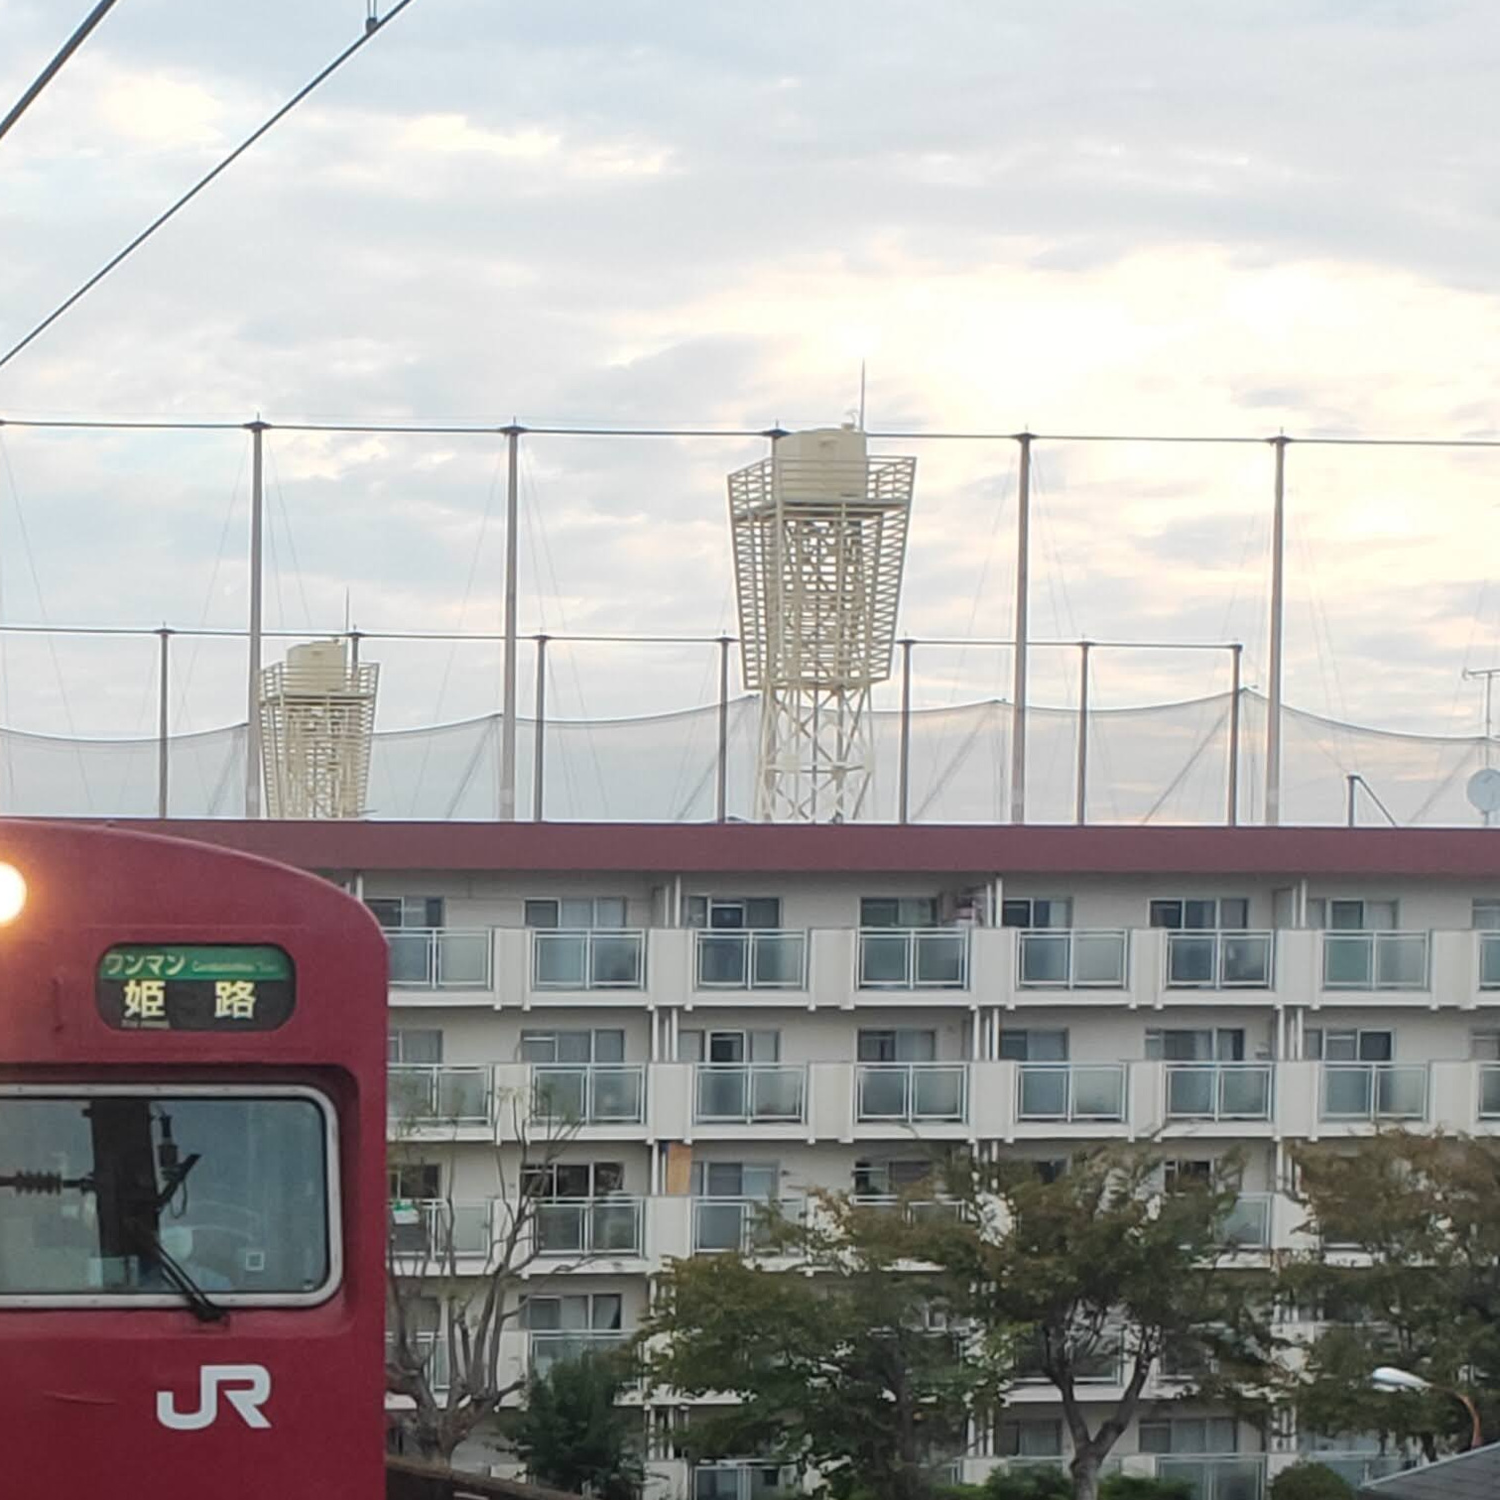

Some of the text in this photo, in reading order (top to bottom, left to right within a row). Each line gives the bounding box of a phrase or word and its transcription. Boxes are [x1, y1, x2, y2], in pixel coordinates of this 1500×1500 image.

[105, 954, 185, 975] ワンマン
[123, 980, 256, 1019] 姫路
[156, 1364, 272, 1430] JR
